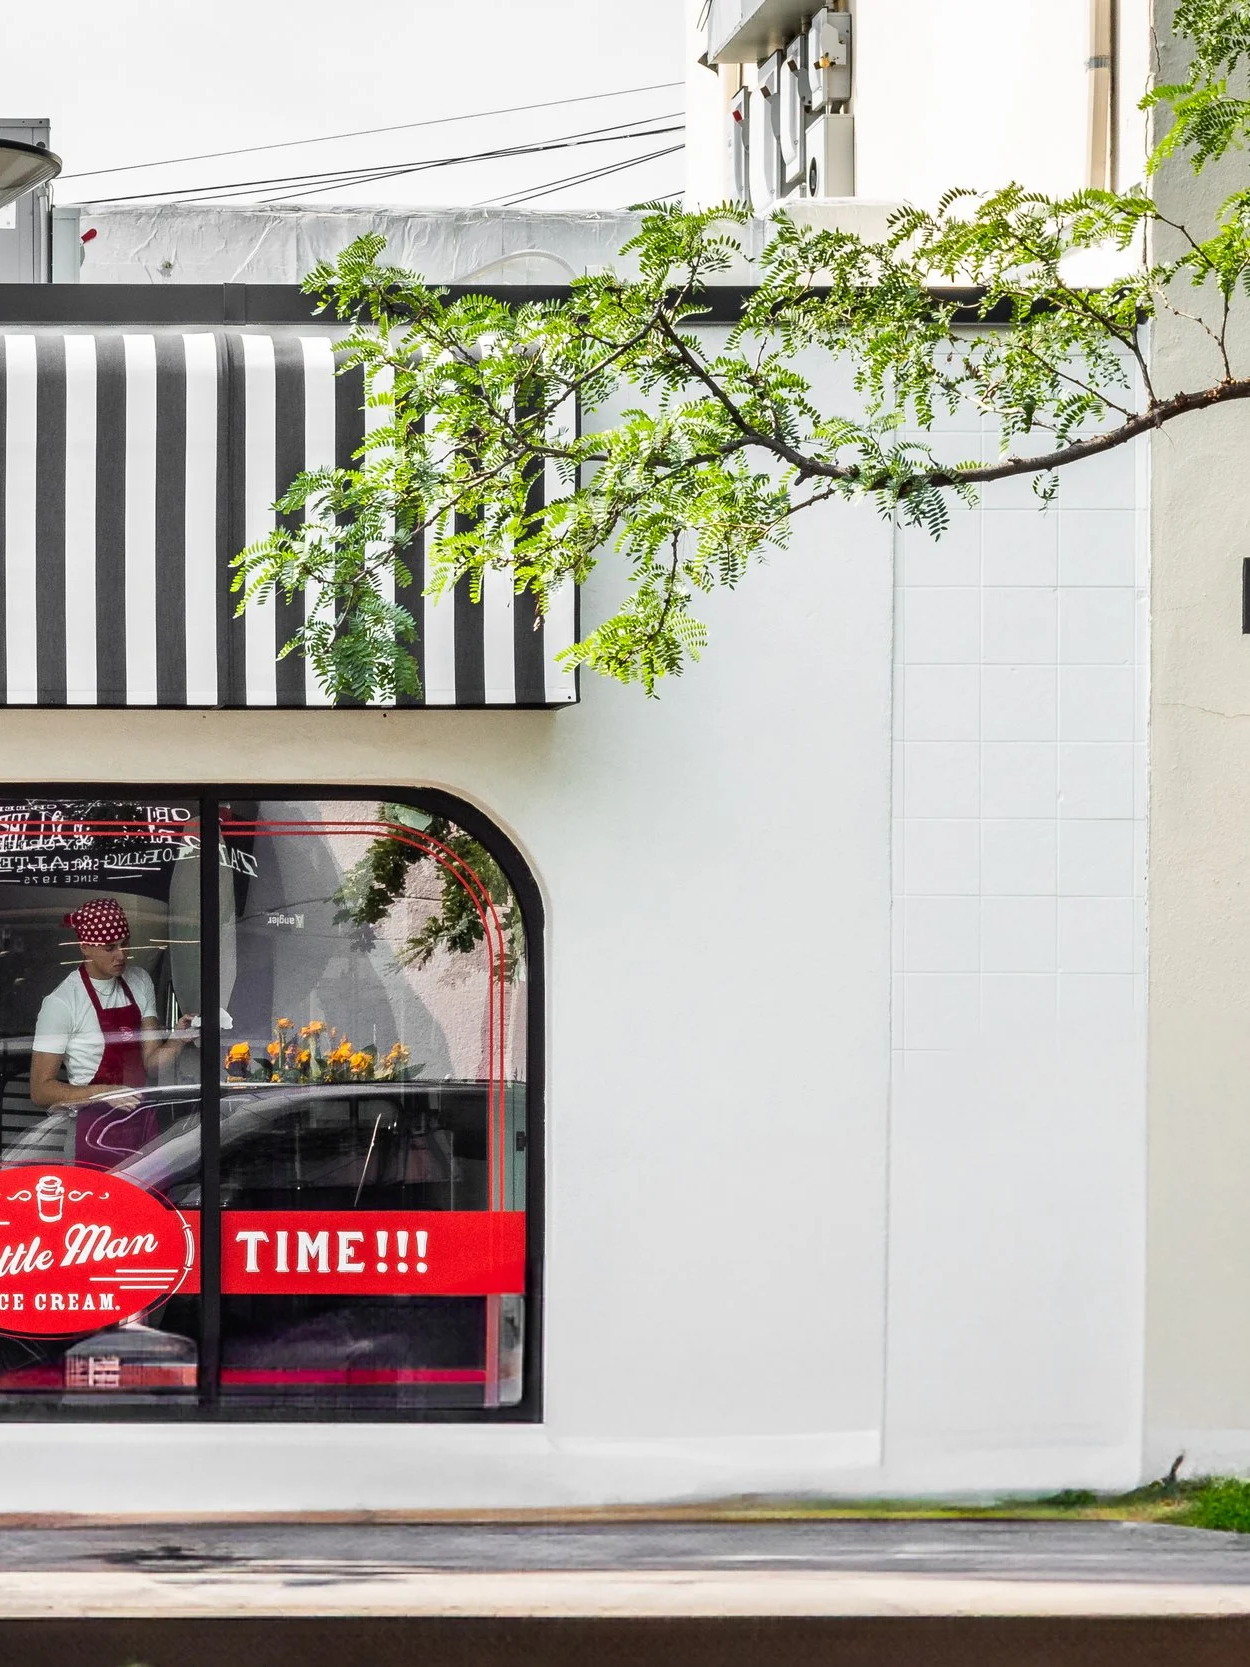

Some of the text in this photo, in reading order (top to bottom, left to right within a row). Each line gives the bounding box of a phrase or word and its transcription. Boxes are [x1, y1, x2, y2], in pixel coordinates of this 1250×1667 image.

[60, 1223, 159, 1267] Man
[235, 1230, 428, 1274] TIME!!!
[34, 1293, 121, 1311] CREAM.
